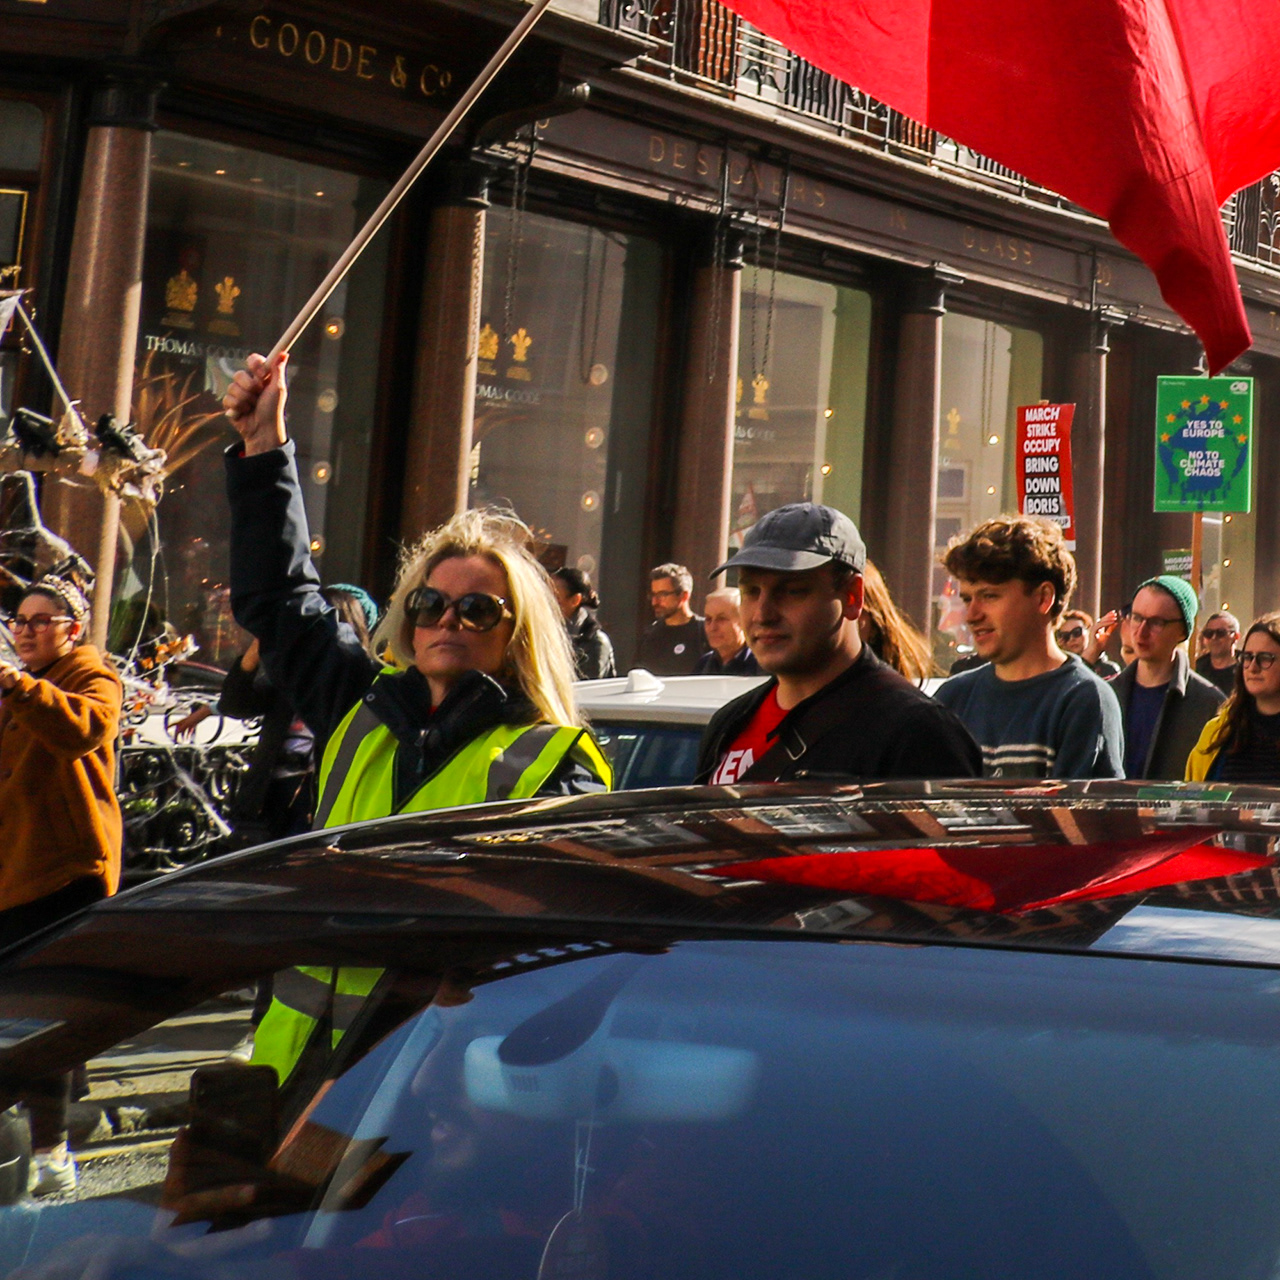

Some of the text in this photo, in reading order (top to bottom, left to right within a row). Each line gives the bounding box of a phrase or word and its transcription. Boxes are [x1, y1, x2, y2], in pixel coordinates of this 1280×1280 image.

[249, 15, 377, 78] GOODE
[389, 56, 407, 88] &
[474, 384, 503, 400] OMAS
[1025, 407, 1060, 422] MARCH
[1027, 423, 1057, 438] STRIKE
[1187, 420, 1223, 430] YES TO
[1182, 429, 1225, 438] EUROPE
[1024, 438, 1061, 453] OCCUPY
[1188, 451, 1219, 459] NO TO
[1025, 457, 1059, 474] BRING
[1180, 459, 1225, 468] CLIMATE
[1184, 468, 1221, 477] CHAOS
[1025, 477, 1060, 494] DOWN
[1028, 498, 1060, 514] BORIS
